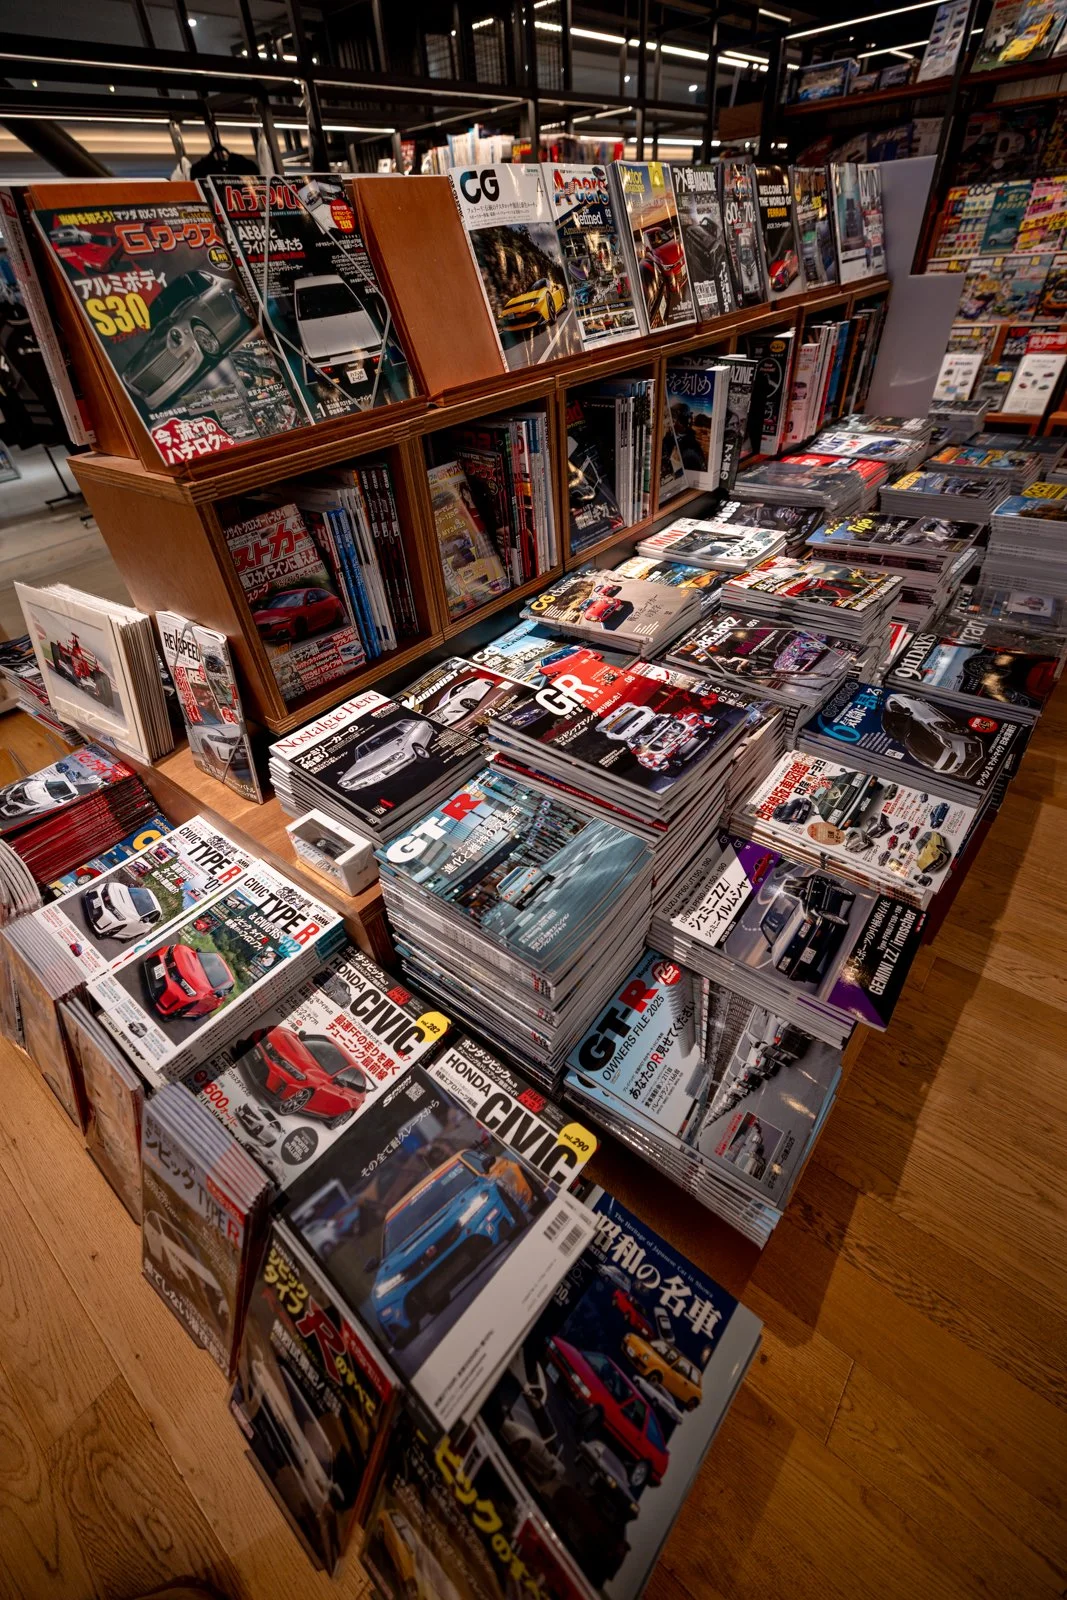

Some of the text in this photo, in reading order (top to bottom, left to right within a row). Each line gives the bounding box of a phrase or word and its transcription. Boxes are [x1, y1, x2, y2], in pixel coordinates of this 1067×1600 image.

[459, 168, 499, 204] CG
[74, 270, 168, 300] アルミボディ
[85, 292, 151, 337] S30
[649, 529, 688, 547] MINI
[847, 517, 874, 534] Tipo
[530, 593, 556, 612] CG
[894, 632, 938, 681] 911DAYS
[535, 673, 600, 716] GR
[564, 689, 604, 720] magazine
[275, 694, 380, 754] Nostalgic Hero
[294, 725, 359, 763] ファミリーカーの
[386, 792, 484, 864] GT-R
[178, 827, 240, 884] CIVIC TYPE R
[244, 877, 267, 899] CIVIC
[250, 891, 300, 936] TYPE
[253, 913, 275, 934] CIVIC
[299, 915, 321, 946] R
[869, 961, 894, 996] GEMINI
[883, 949, 900, 964] ZZ
[893, 909, 918, 947] irmscher
[330, 957, 426, 1055] HONDA CIVIC
[578, 979, 660, 1072] GT-R
[325, 1022, 391, 1082] チューニング最前線
[333, 1013, 401, 1076] 最速FFの走りを磨く
[461, 1038, 511, 1082] ホンダ・シビック
[602, 1036, 637, 1081] OWNERS
[633, 1014, 651, 1038] FILE
[649, 994, 665, 1017] 2025
[629, 1002, 697, 1100] あなたのR見せてください
[445, 1053, 492, 1095] HONDA
[476, 1092, 577, 1186] CIVIC
[562, 1131, 591, 1154] vol.290
[225, 1214, 240, 1249] R
[625, 1218, 648, 1243] Heritage
[654, 1244, 681, 1268] Japanese
[268, 1247, 309, 1300] シビック
[595, 1210, 724, 1340] 昭和の名車
[264, 1263, 303, 1315] タイプ
[295, 1296, 346, 1388] R
